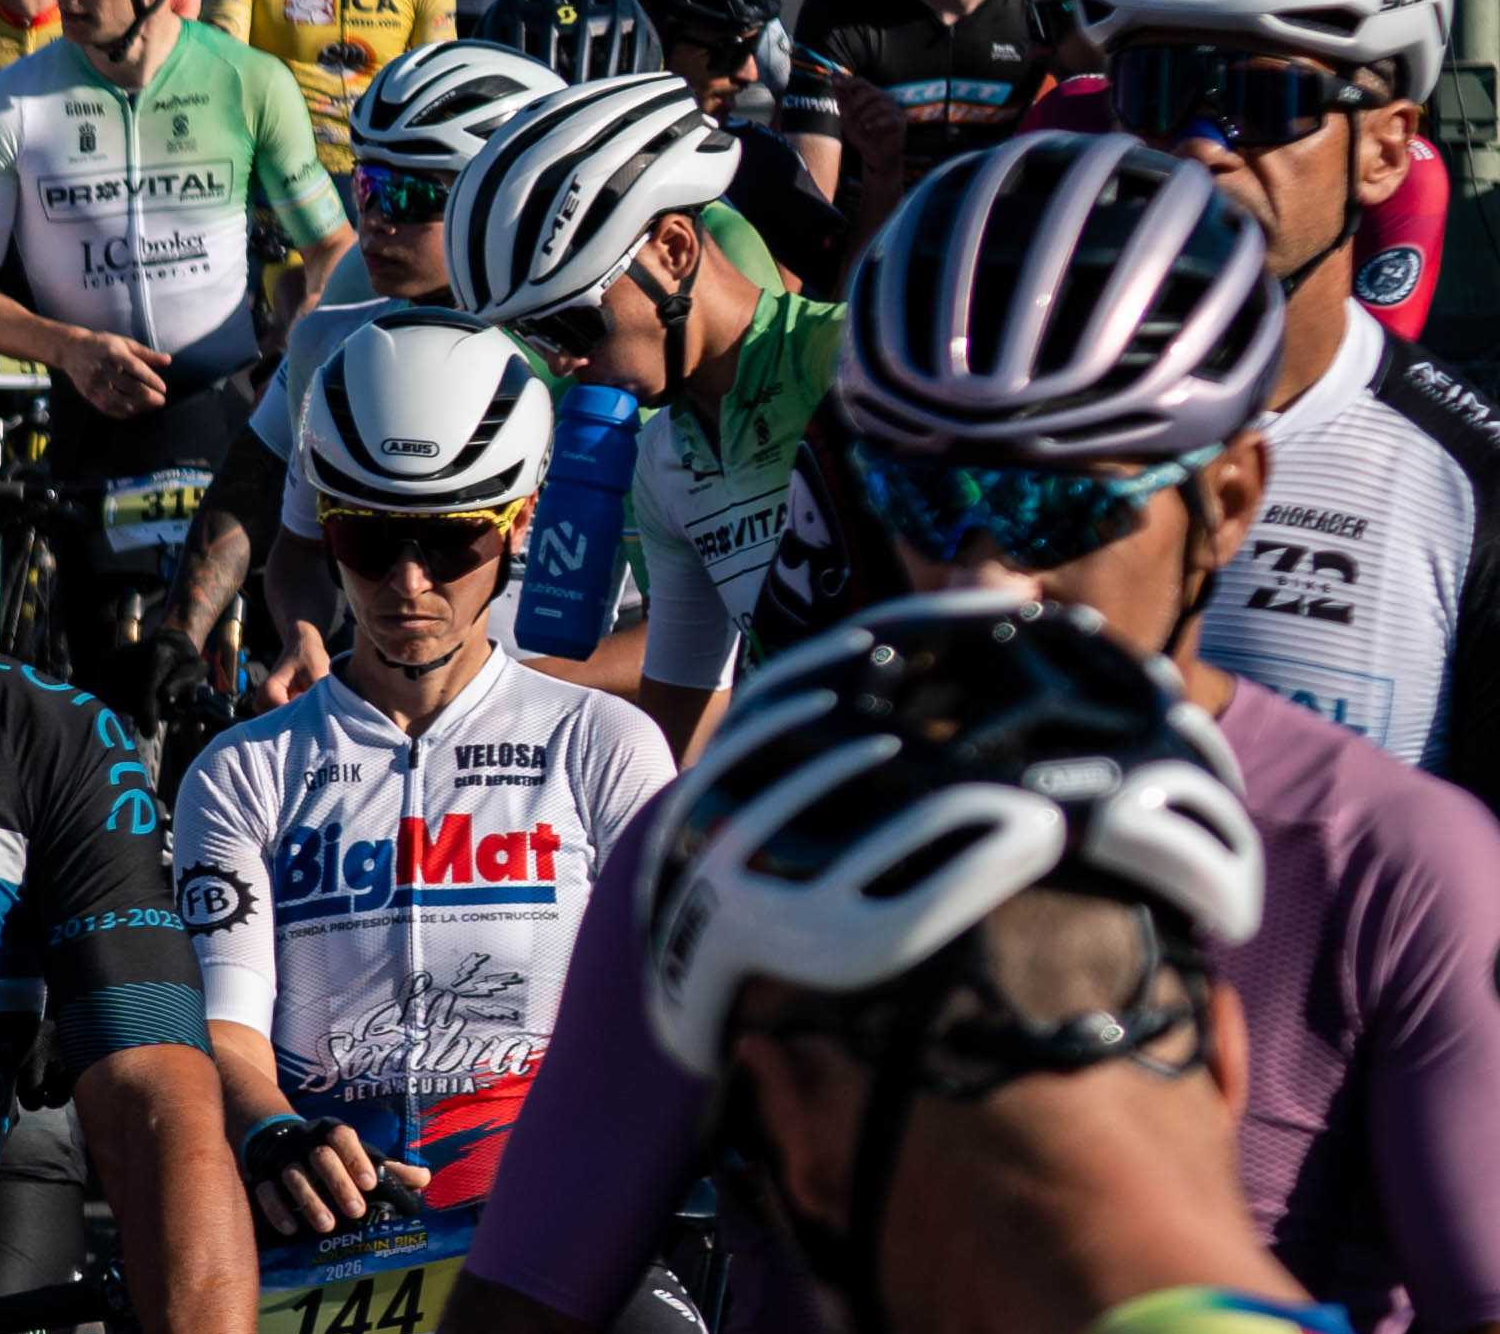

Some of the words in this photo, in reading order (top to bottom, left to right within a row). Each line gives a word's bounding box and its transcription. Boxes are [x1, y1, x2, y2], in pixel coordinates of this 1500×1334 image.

[541, 174, 583, 257] MET
[388, 441, 434, 456] ABUS
[1261, 503, 1369, 542] BIORACER
[1277, 575, 1334, 593] BIKE
[454, 741, 548, 770] VELOSA
[273, 812, 562, 914] BigMat
[182, 875, 230, 916] FB
[49, 907, 186, 946] 2013-2023
[329, 913, 414, 933] PROFESIONAL
[419, 911, 437, 925] DE
[438, 912, 458, 924] LA
[460, 909, 559, 924] CONSTRUCCIÓN
[352, 970, 458, 1042] La
[297, 1017, 552, 1094] Sombra
[318, 1231, 364, 1254] OPEN
[394, 1231, 429, 1249] BIKE
[325, 1258, 363, 1283] 2026
